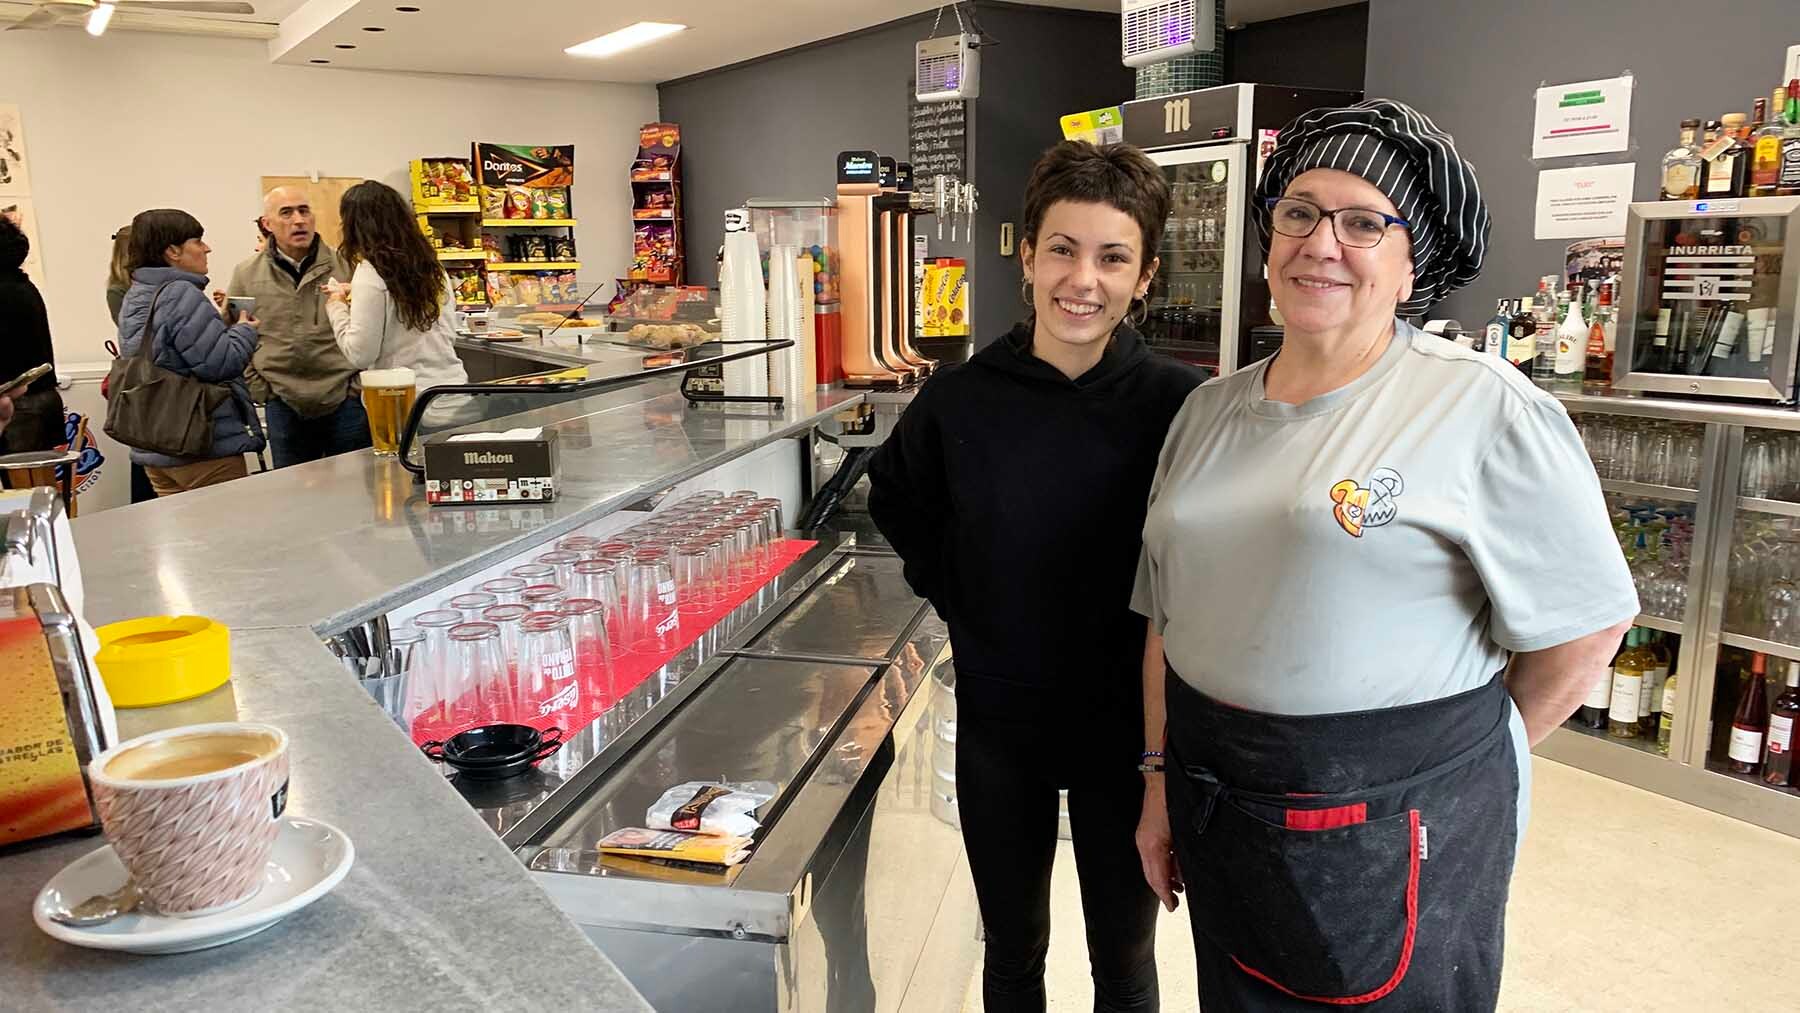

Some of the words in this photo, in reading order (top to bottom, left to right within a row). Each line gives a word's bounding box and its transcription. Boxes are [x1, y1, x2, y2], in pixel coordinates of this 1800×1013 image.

[484, 160, 523, 173] Doritos
[1669, 245, 1753, 255] INURRIETA
[464, 452, 513, 465] Mahou
